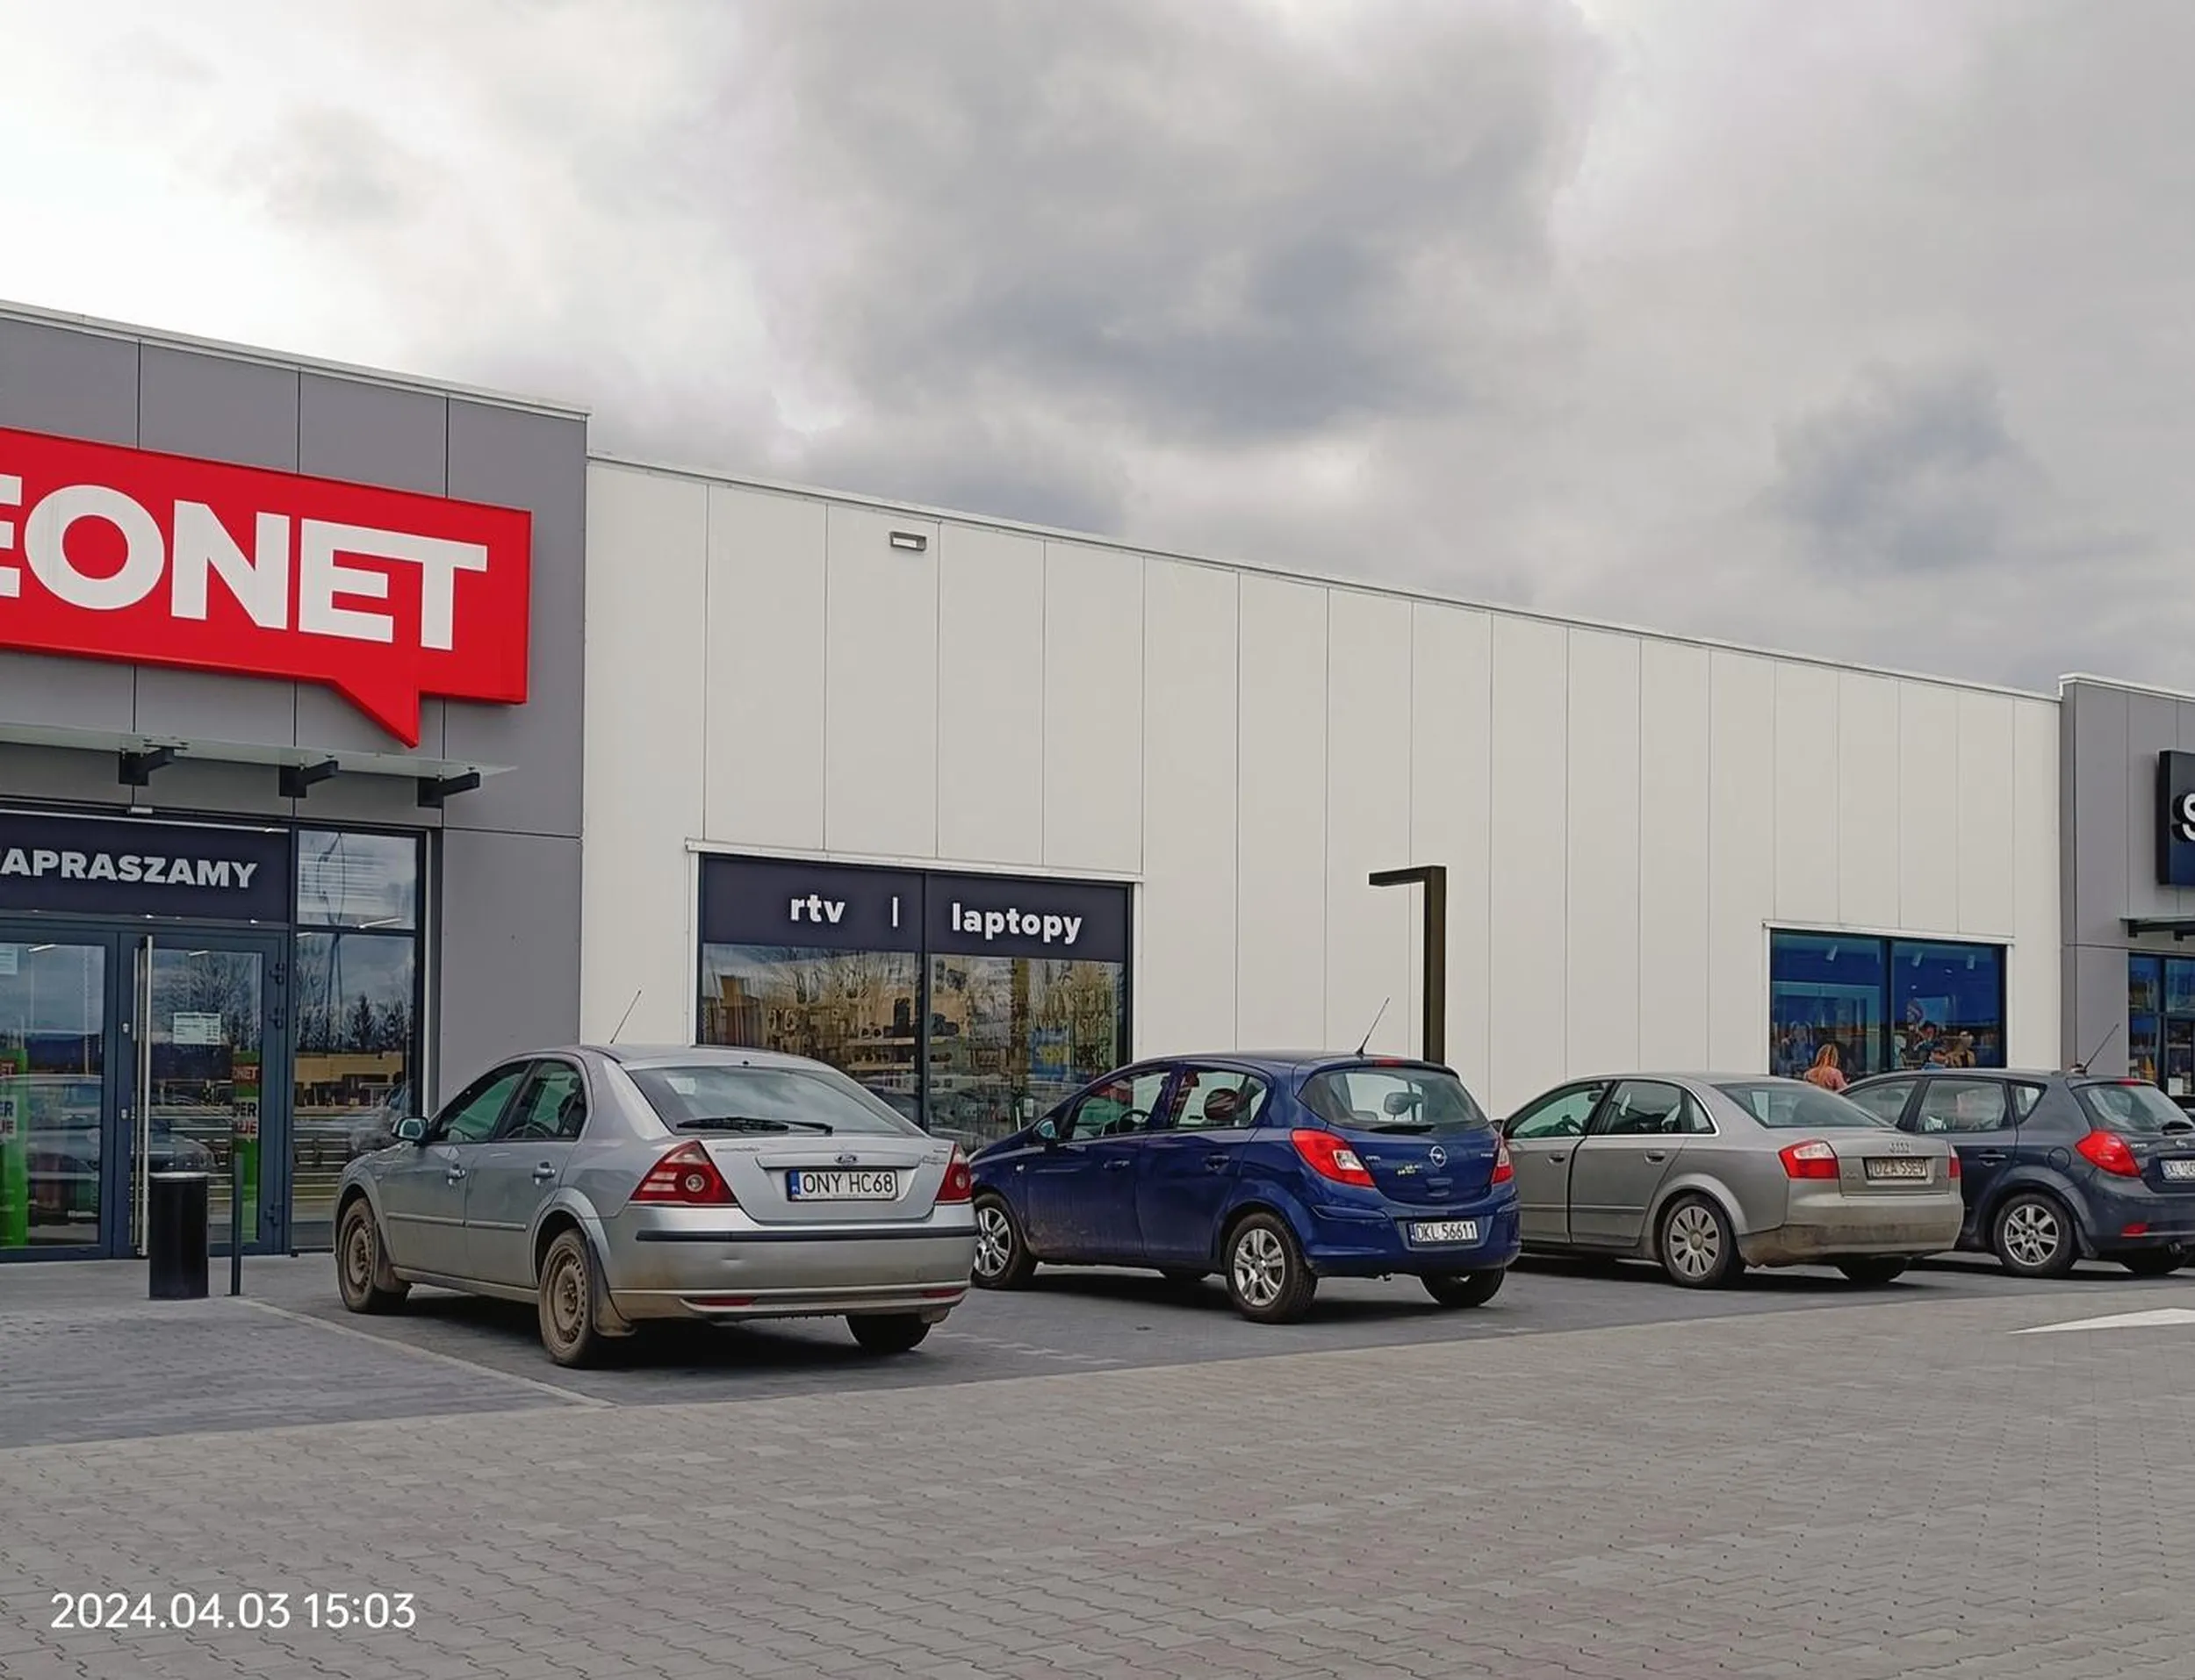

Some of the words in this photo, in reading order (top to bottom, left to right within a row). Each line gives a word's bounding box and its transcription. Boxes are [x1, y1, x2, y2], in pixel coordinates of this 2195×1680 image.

[0, 474, 488, 651] ONET
[0, 848, 258, 888] APRASZAMY
[789, 894, 846, 923] rtv
[952, 902, 1083, 944] laptopy
[802, 1174, 842, 1193] ONY
[849, 1174, 894, 1193] HC68
[1415, 1224, 1439, 1240] DKL
[1442, 1223, 1476, 1239] 56611
